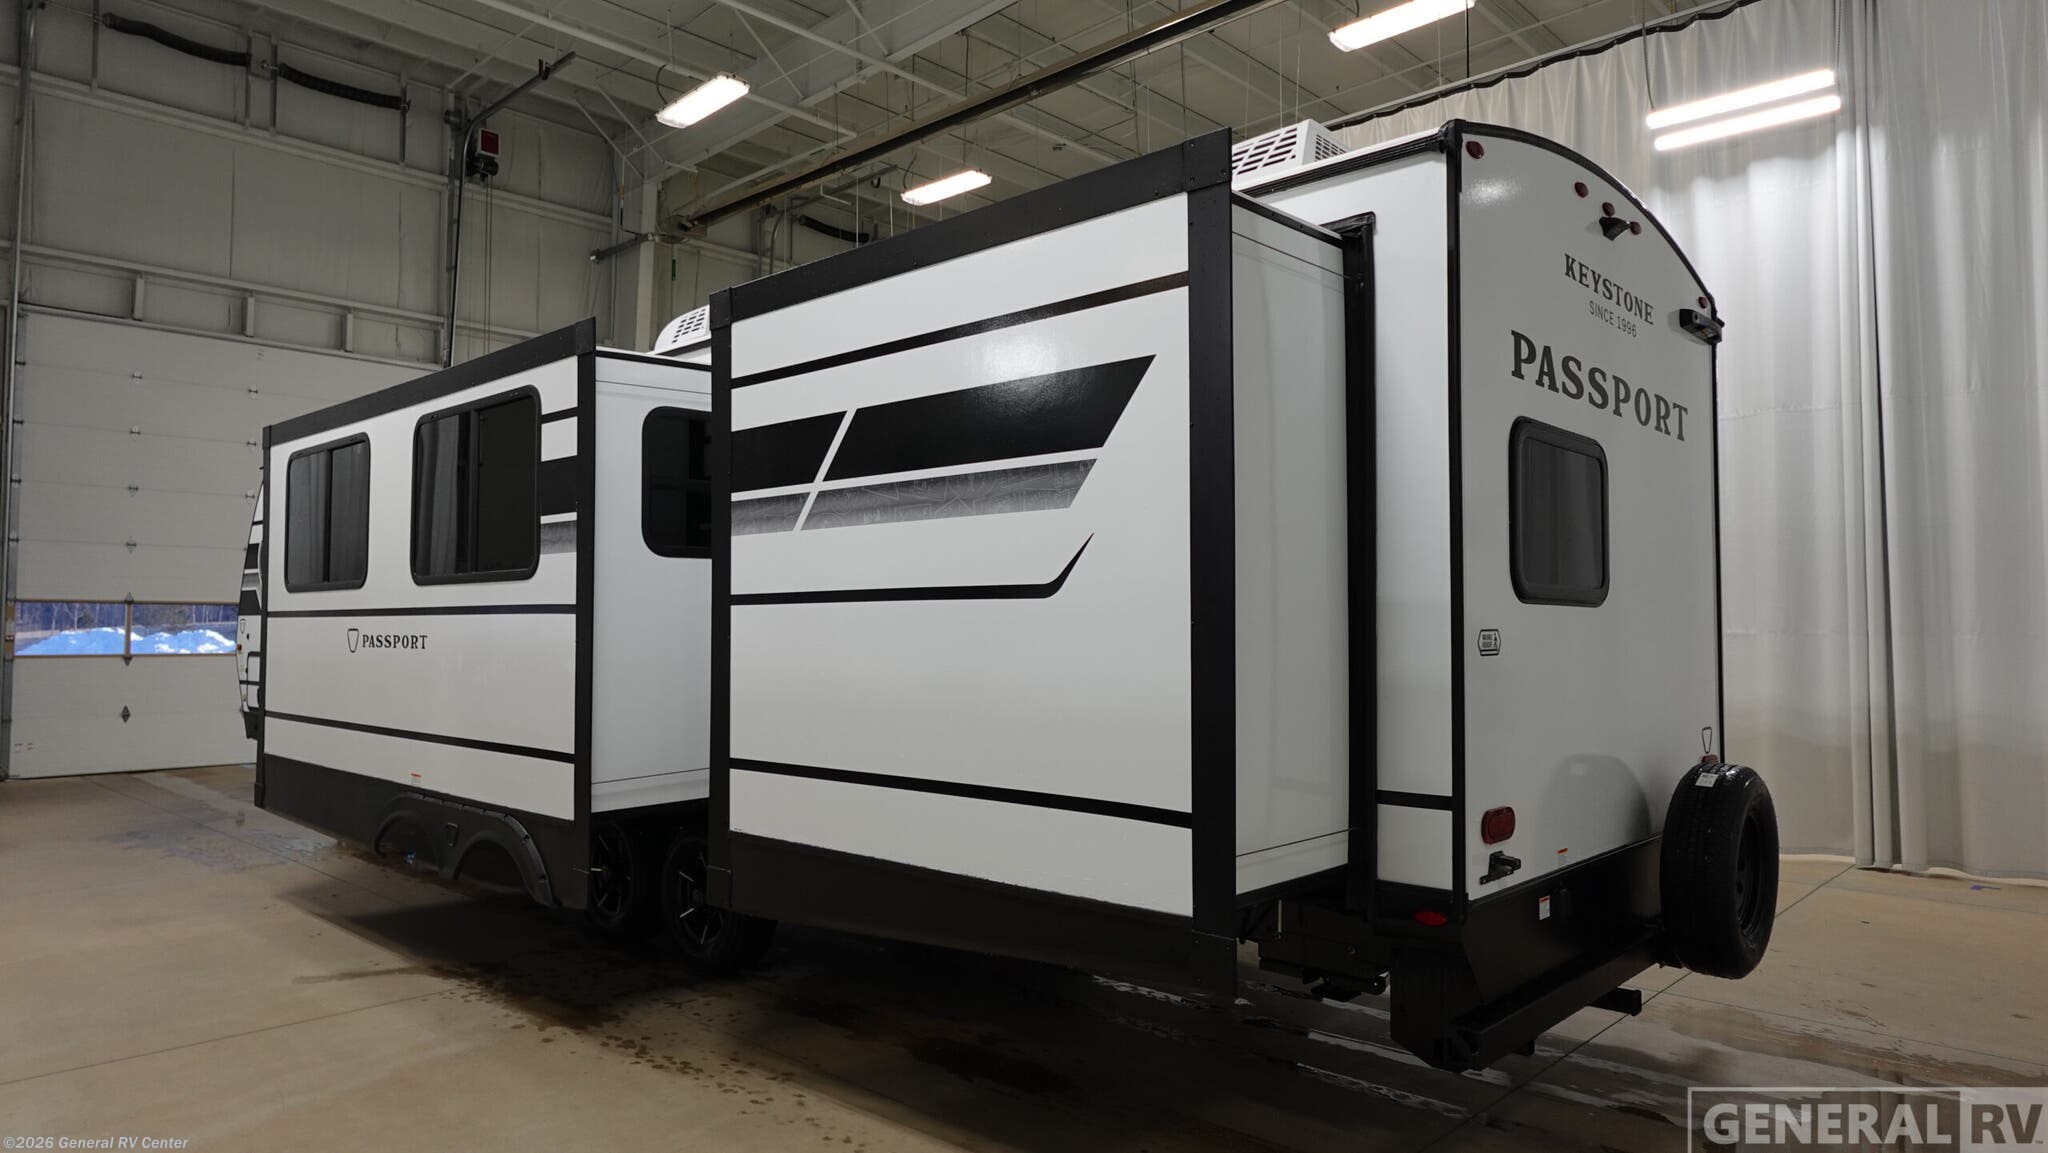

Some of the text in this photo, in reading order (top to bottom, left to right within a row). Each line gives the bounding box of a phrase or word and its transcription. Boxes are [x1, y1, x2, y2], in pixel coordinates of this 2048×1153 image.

[1564, 253, 1654, 325] KEYSTONE
[1589, 300, 1637, 338] SINCE 1996
[1510, 329, 1689, 441] PASSPORT
[361, 634, 428, 649] PASSPORT
